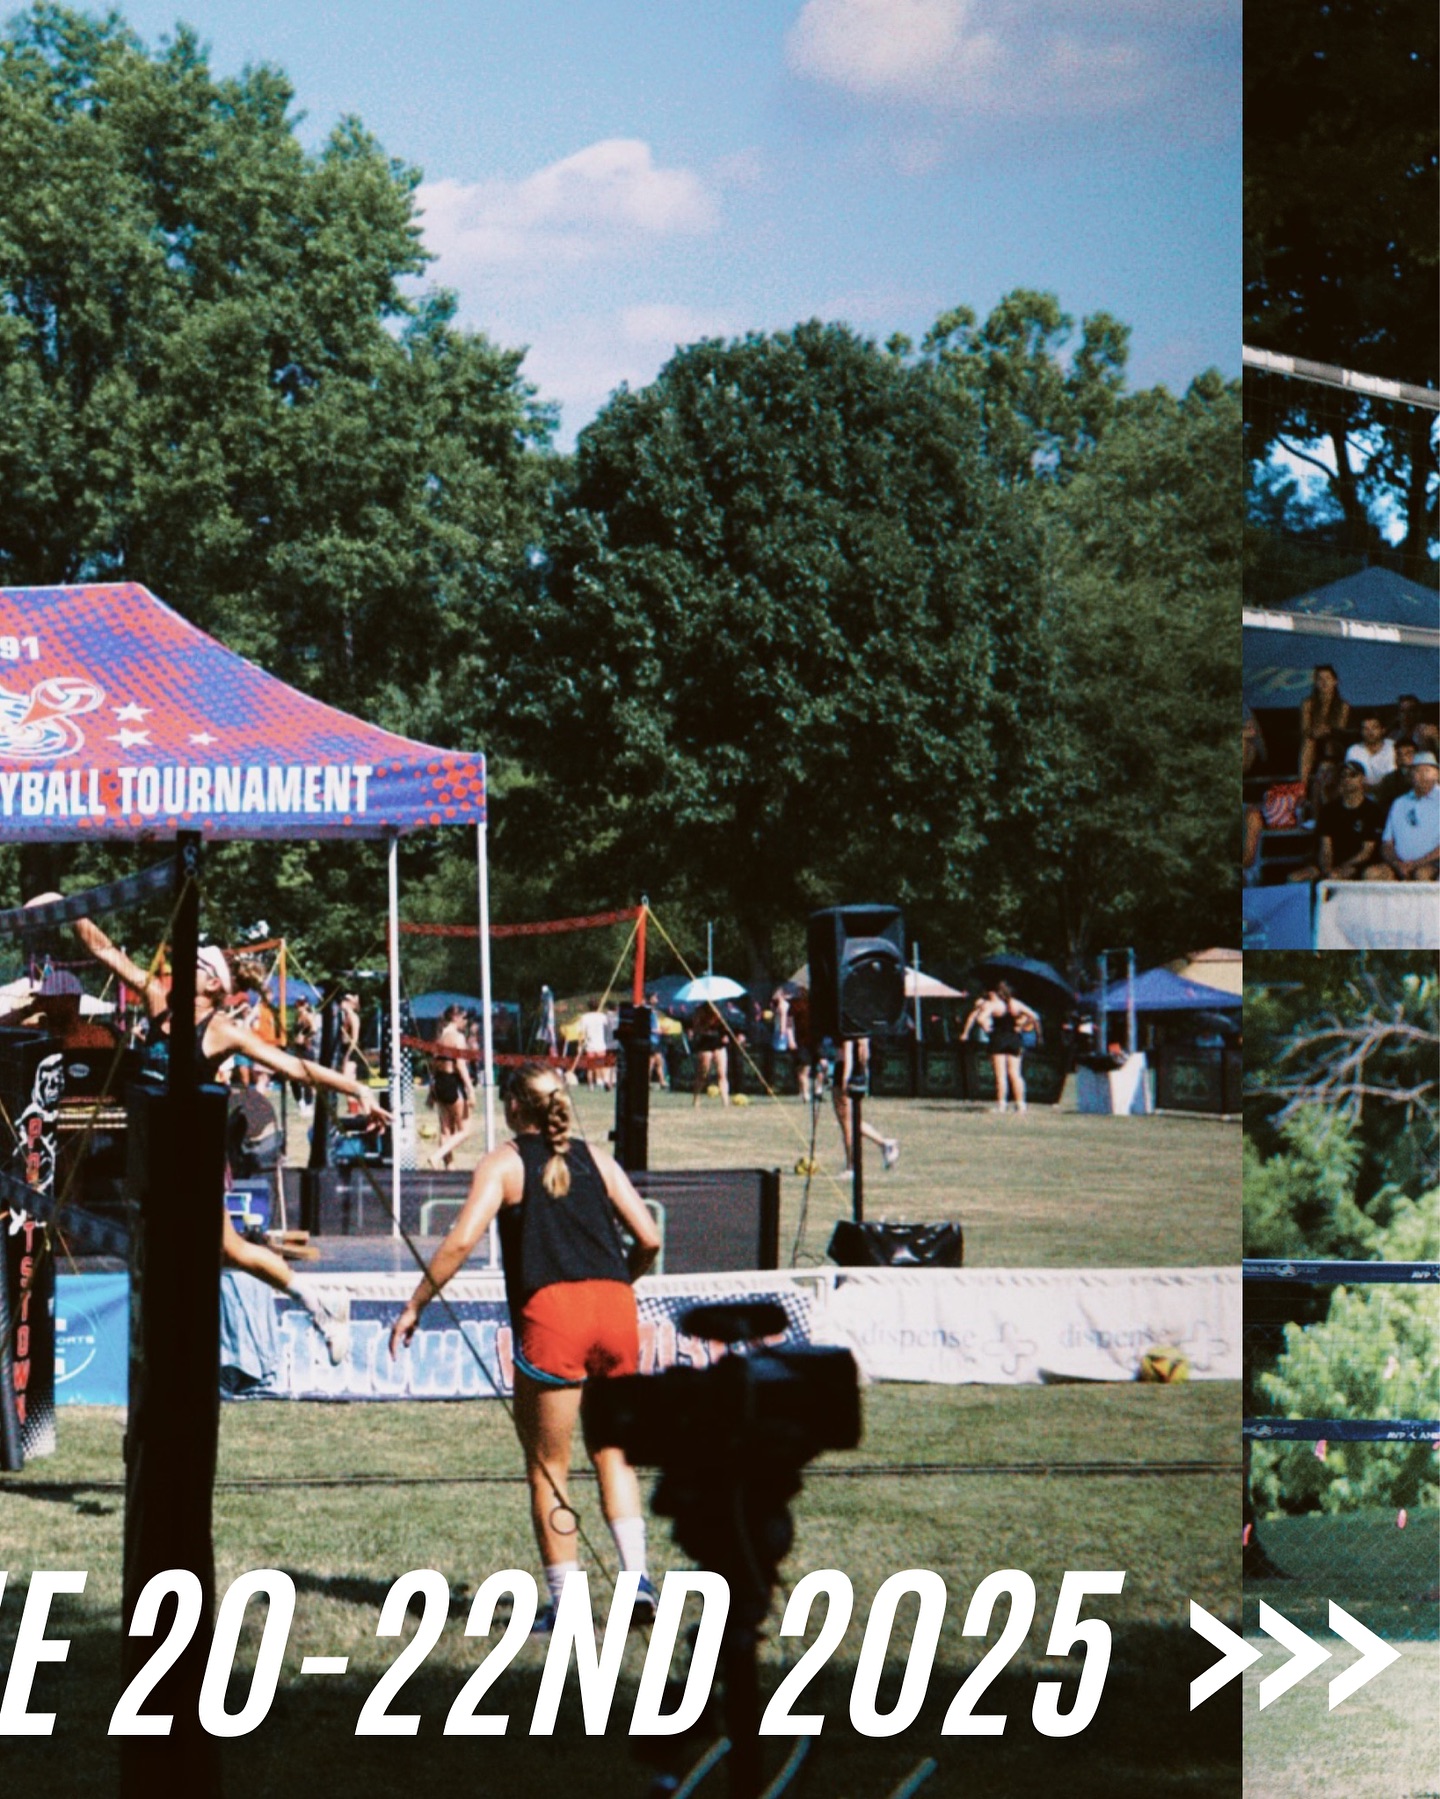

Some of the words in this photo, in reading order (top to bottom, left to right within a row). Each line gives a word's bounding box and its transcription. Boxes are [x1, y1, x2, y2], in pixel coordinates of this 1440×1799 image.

[0, 769, 106, 815] YBALL
[117, 765, 373, 814] TOURNAMENT
[861, 1321, 977, 1354] dispense
